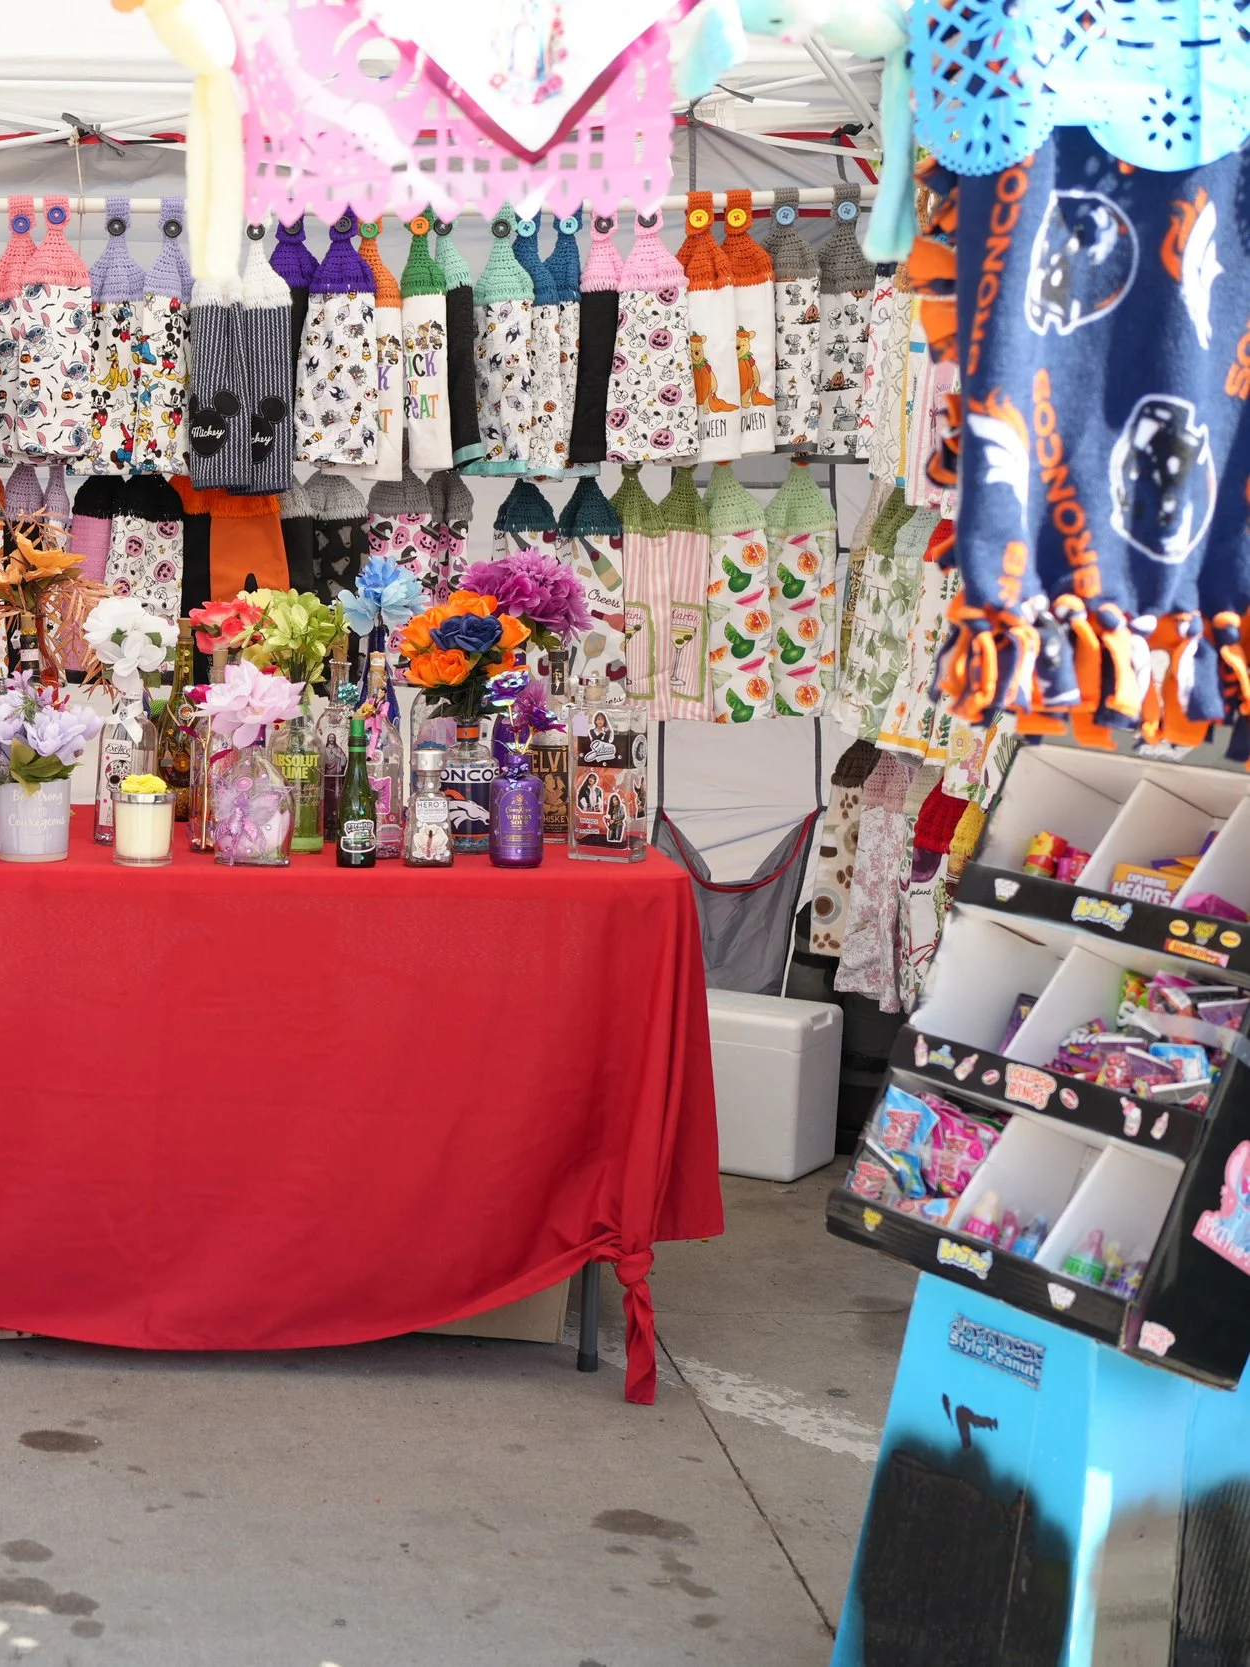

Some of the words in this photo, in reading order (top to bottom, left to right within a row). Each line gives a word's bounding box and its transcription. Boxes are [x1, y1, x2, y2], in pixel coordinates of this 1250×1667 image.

[191, 424, 226, 440] Mickey
[251, 431, 273, 446] ckey
[588, 588, 621, 608] Cheers
[532, 750, 568, 773] ELVI
[282, 766, 309, 779] LIME
[418, 800, 447, 808] HERO'S
[544, 815, 569, 824] HISKEY
[910, 889, 932, 902] plant
